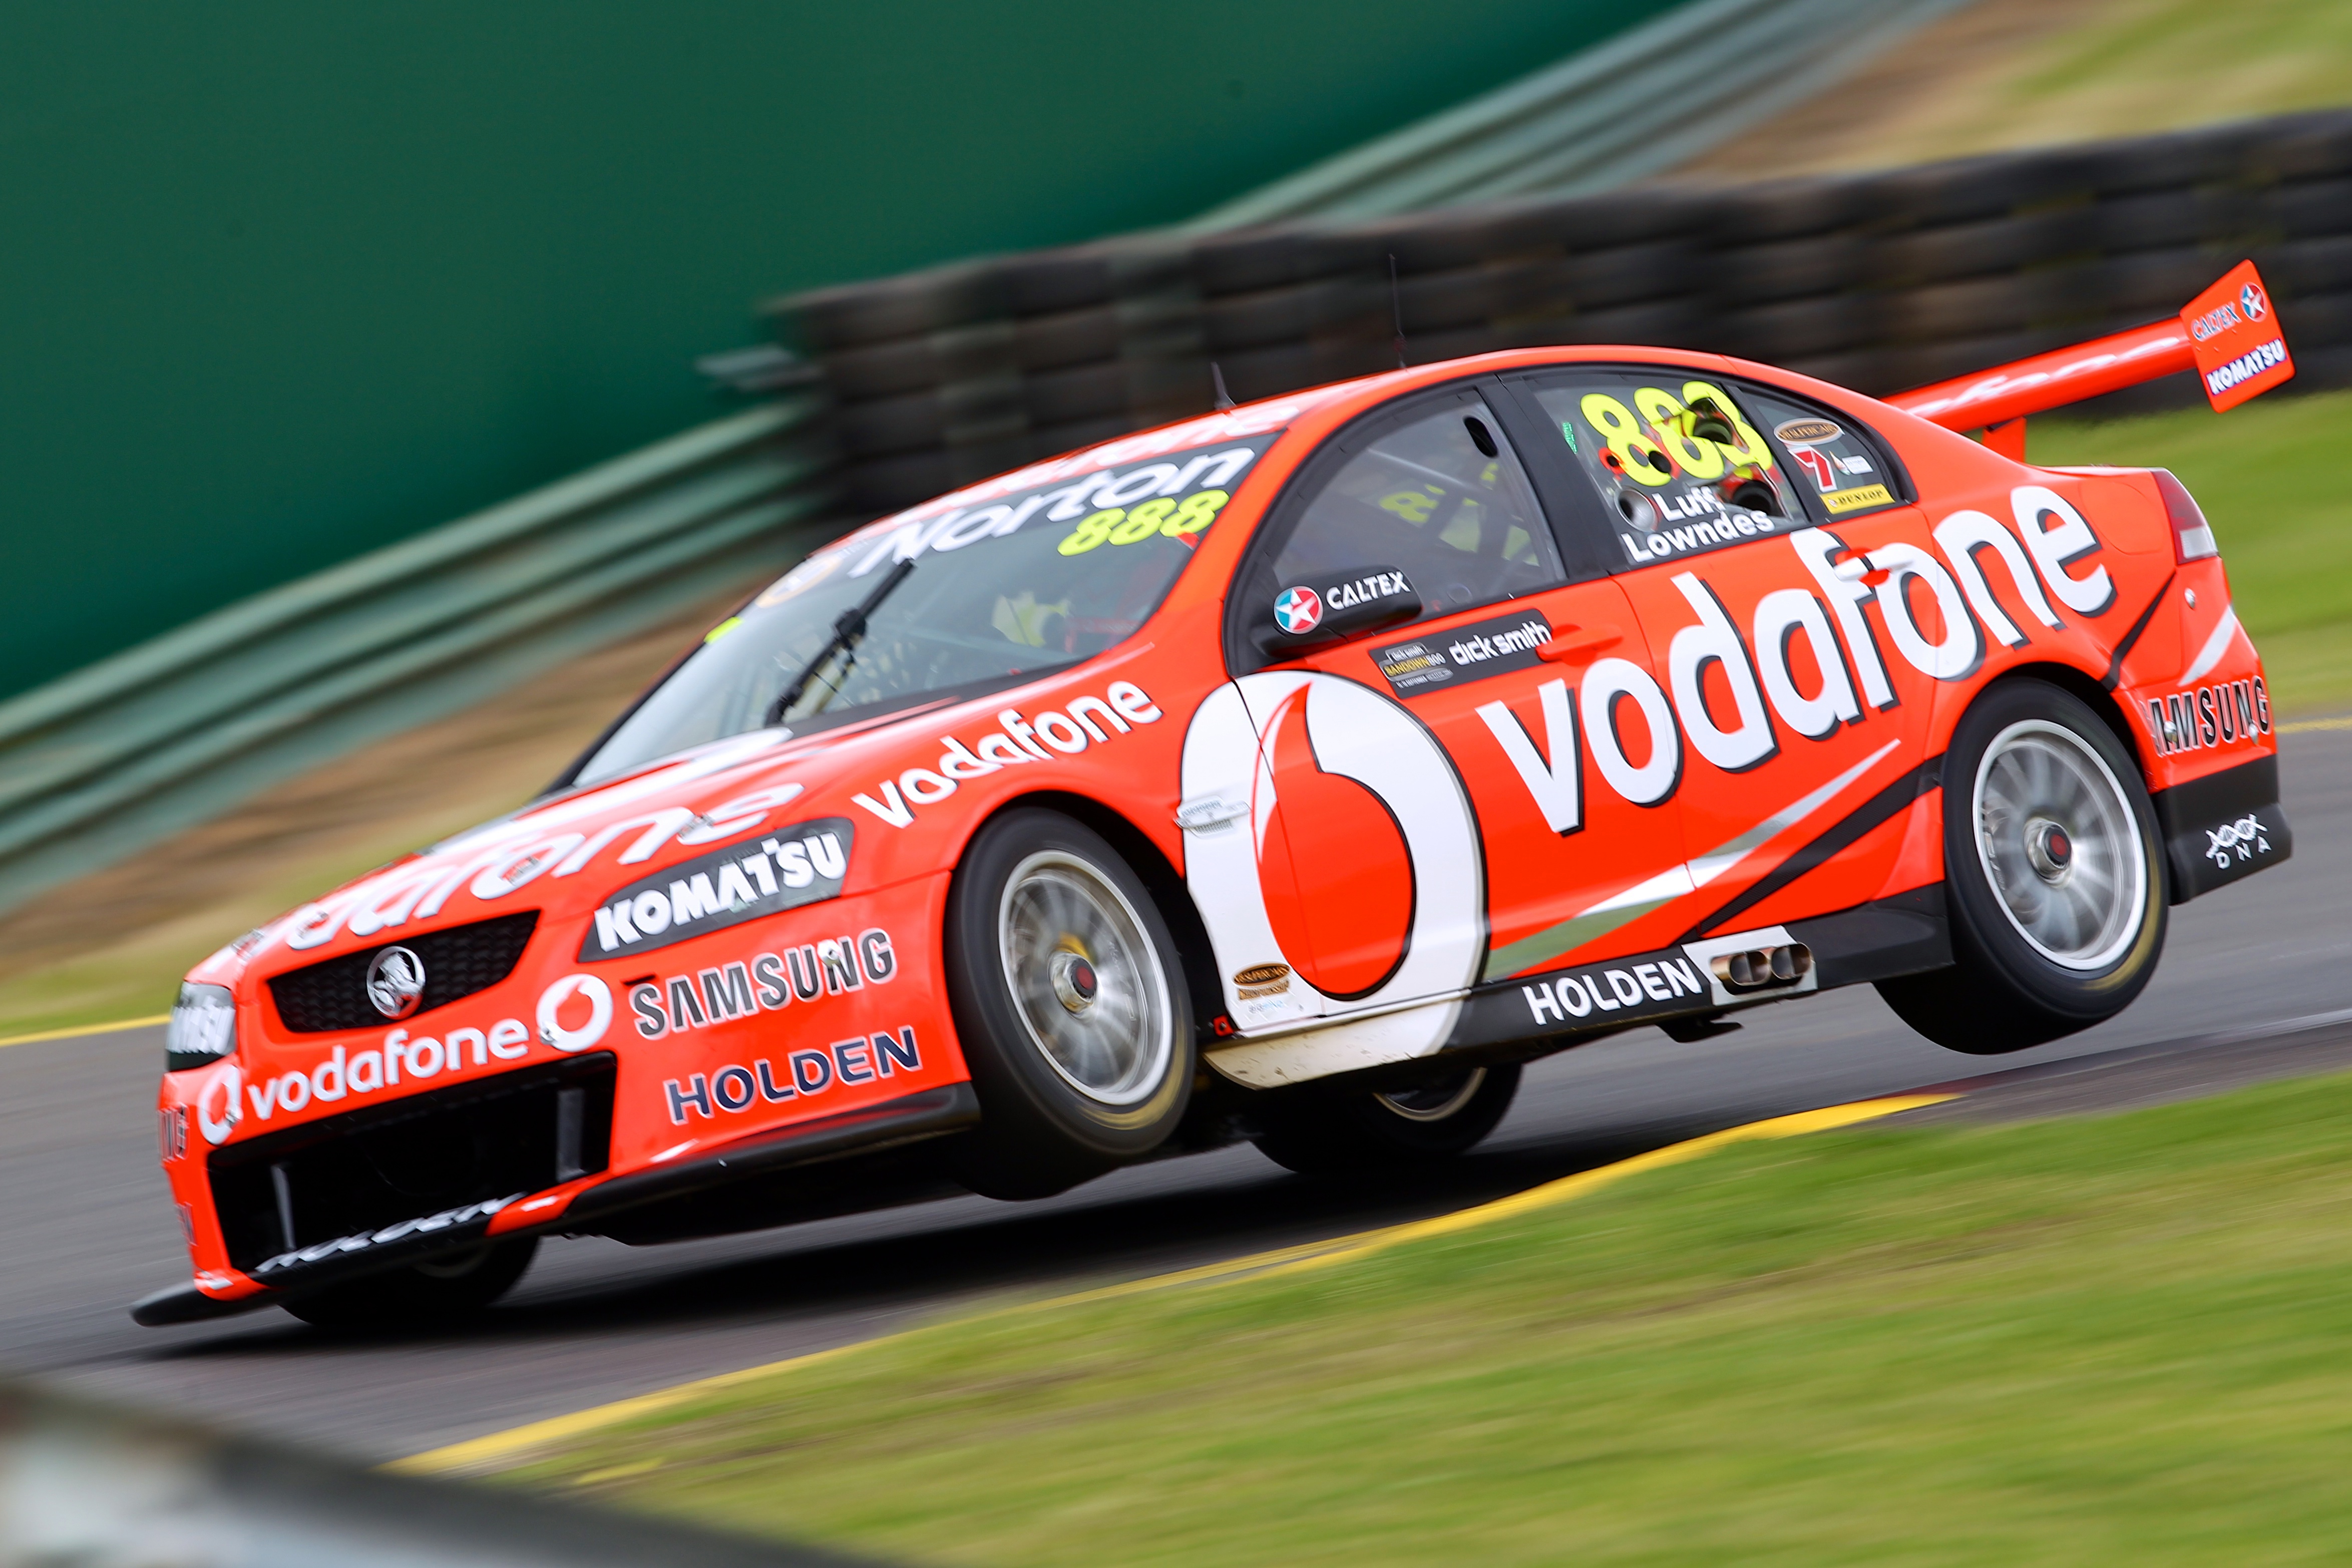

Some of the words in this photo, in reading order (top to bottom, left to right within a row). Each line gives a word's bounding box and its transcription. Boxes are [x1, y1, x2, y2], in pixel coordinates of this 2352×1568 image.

[2191, 301, 2242, 342] CALTEX
[2206, 338, 2286, 395] KOMATSU
[847, 448, 1255, 578] Norton
[1057, 490, 1230, 556] 888
[1652, 486, 1725, 522] Luff
[1837, 489, 1884, 506] DUNLOP
[1622, 511, 1775, 563] Lowndes
[1326, 571, 1411, 610] CALTEX
[1448, 634, 1499, 665] dick
[1492, 621, 1553, 655] smith
[1475, 486, 2115, 835] vodafone
[850, 680, 1164, 829] vodafone
[2215, 836, 2272, 870] DNA
[594, 833, 847, 952] KOMATSU
[629, 928, 899, 1040] SAMSUNG
[1521, 958, 1703, 1025] HOLDEN
[247, 1018, 529, 1119] vodafone
[663, 1025, 923, 1125] HOLDEN
